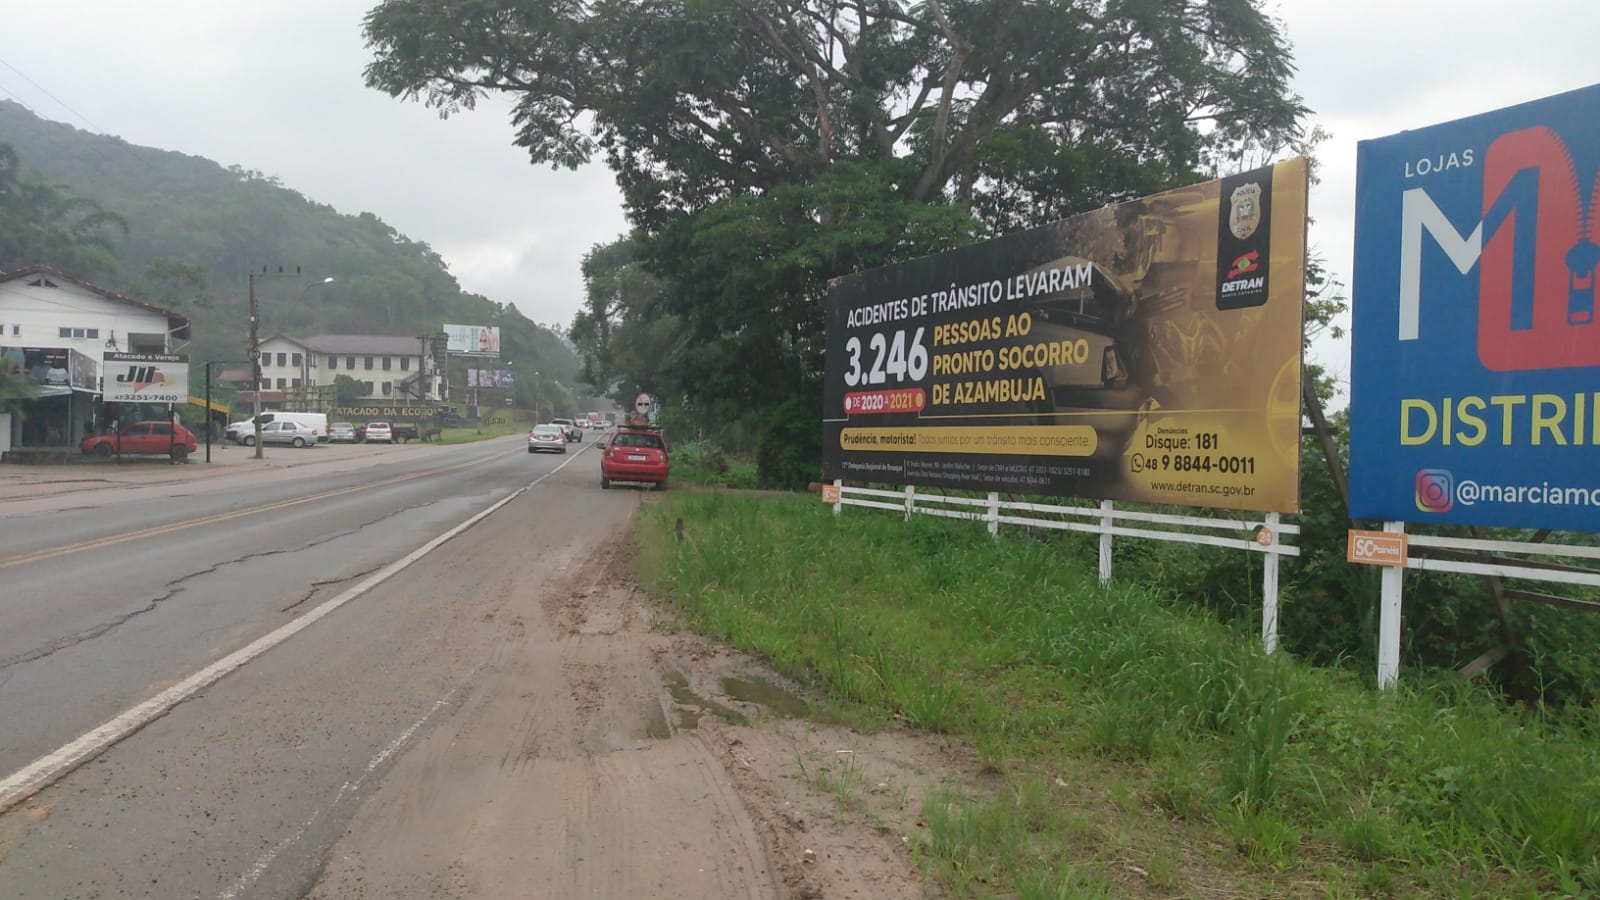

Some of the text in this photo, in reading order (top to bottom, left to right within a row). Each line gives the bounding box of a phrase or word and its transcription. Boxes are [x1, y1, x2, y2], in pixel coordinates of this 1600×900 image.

[1405, 149, 1474, 178] LOJAS
[847, 261, 1093, 328] ACIDENTES DE TRÂNSITO LEVARAM
[1221, 277, 1264, 293] DETRAN
[934, 312, 1032, 347] PESSOAS AO
[844, 327, 928, 386] 3.246
[933, 338, 1089, 376] PRONTO SOCORRO
[124, 393, 178, 402] 3251-7400
[932, 377, 1046, 405] DE AZAMBUJA
[852, 392, 912, 411] DE 2020 A 2021
[336, 407, 379, 416] ATACADO
[384, 407, 397, 416] DA
[1400, 392, 1600, 446] DISTRI
[844, 433, 878, 446] Prudência,
[880, 433, 916, 445] motorista!
[986, 433, 1017, 447] trânsito
[1039, 434, 1089, 447] consciente
[1157, 427, 1188, 435] Denúncias
[1145, 433, 1218, 452] Disque: 181
[1145, 455, 1255, 475] 48 9 8844-0011
[1151, 481, 1256, 497] www.detran.sc.gov.br
[1355, 539, 1374, 557] SC
